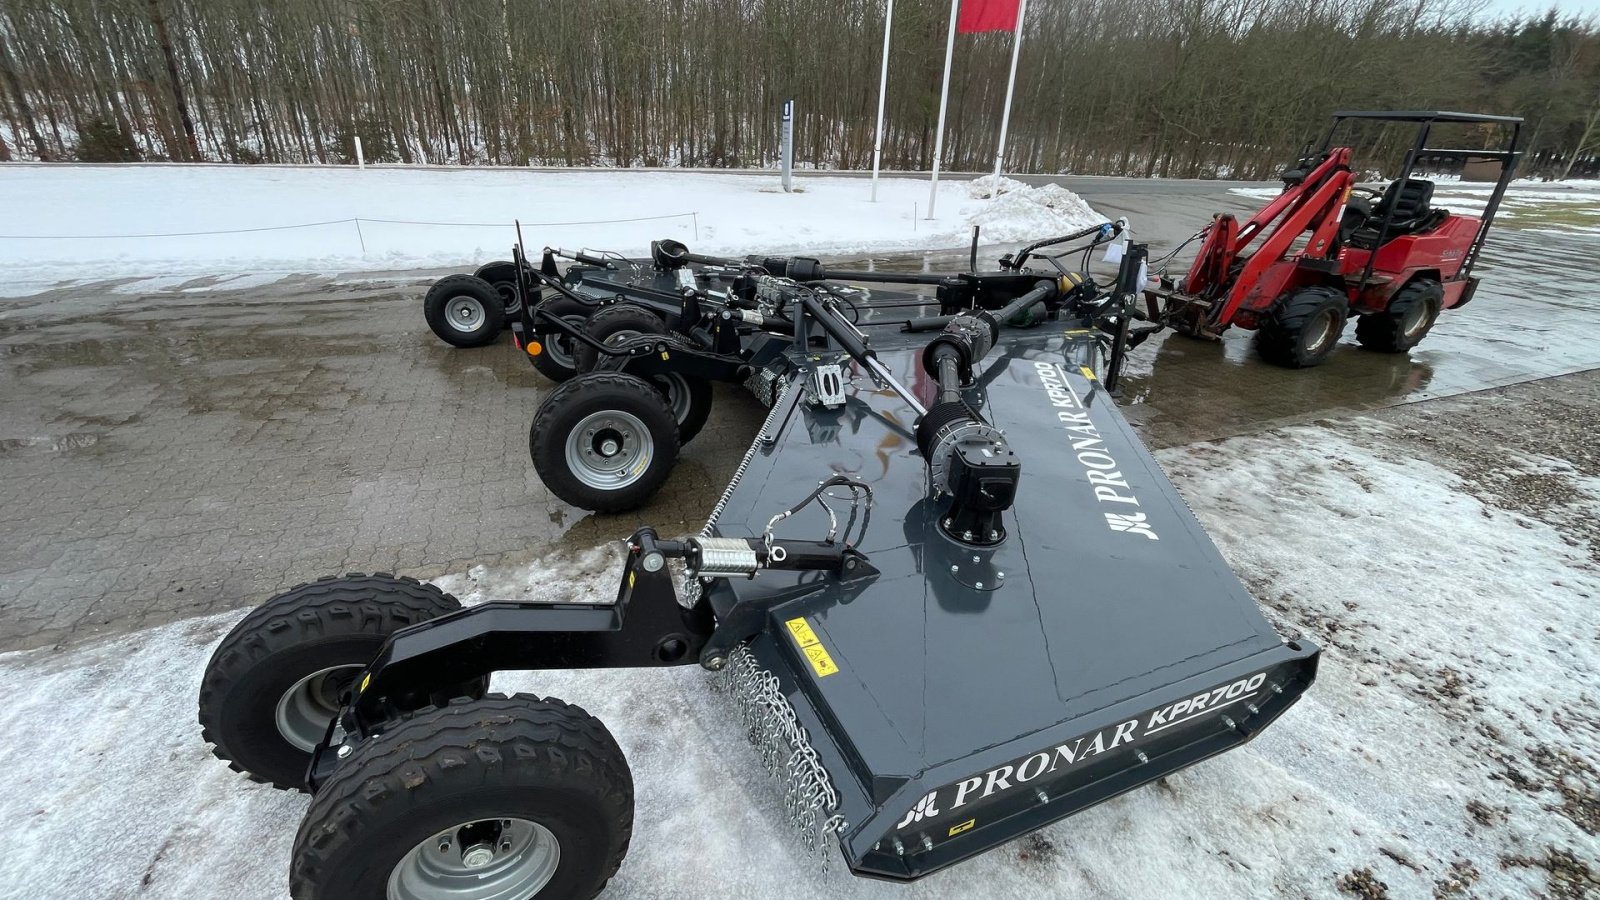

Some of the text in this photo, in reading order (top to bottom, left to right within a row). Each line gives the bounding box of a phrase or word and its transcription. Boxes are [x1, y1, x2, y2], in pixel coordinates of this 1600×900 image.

[1034, 361, 1140, 507] PRONAR KPR700
[950, 672, 1267, 810] PRONAR KPR700
